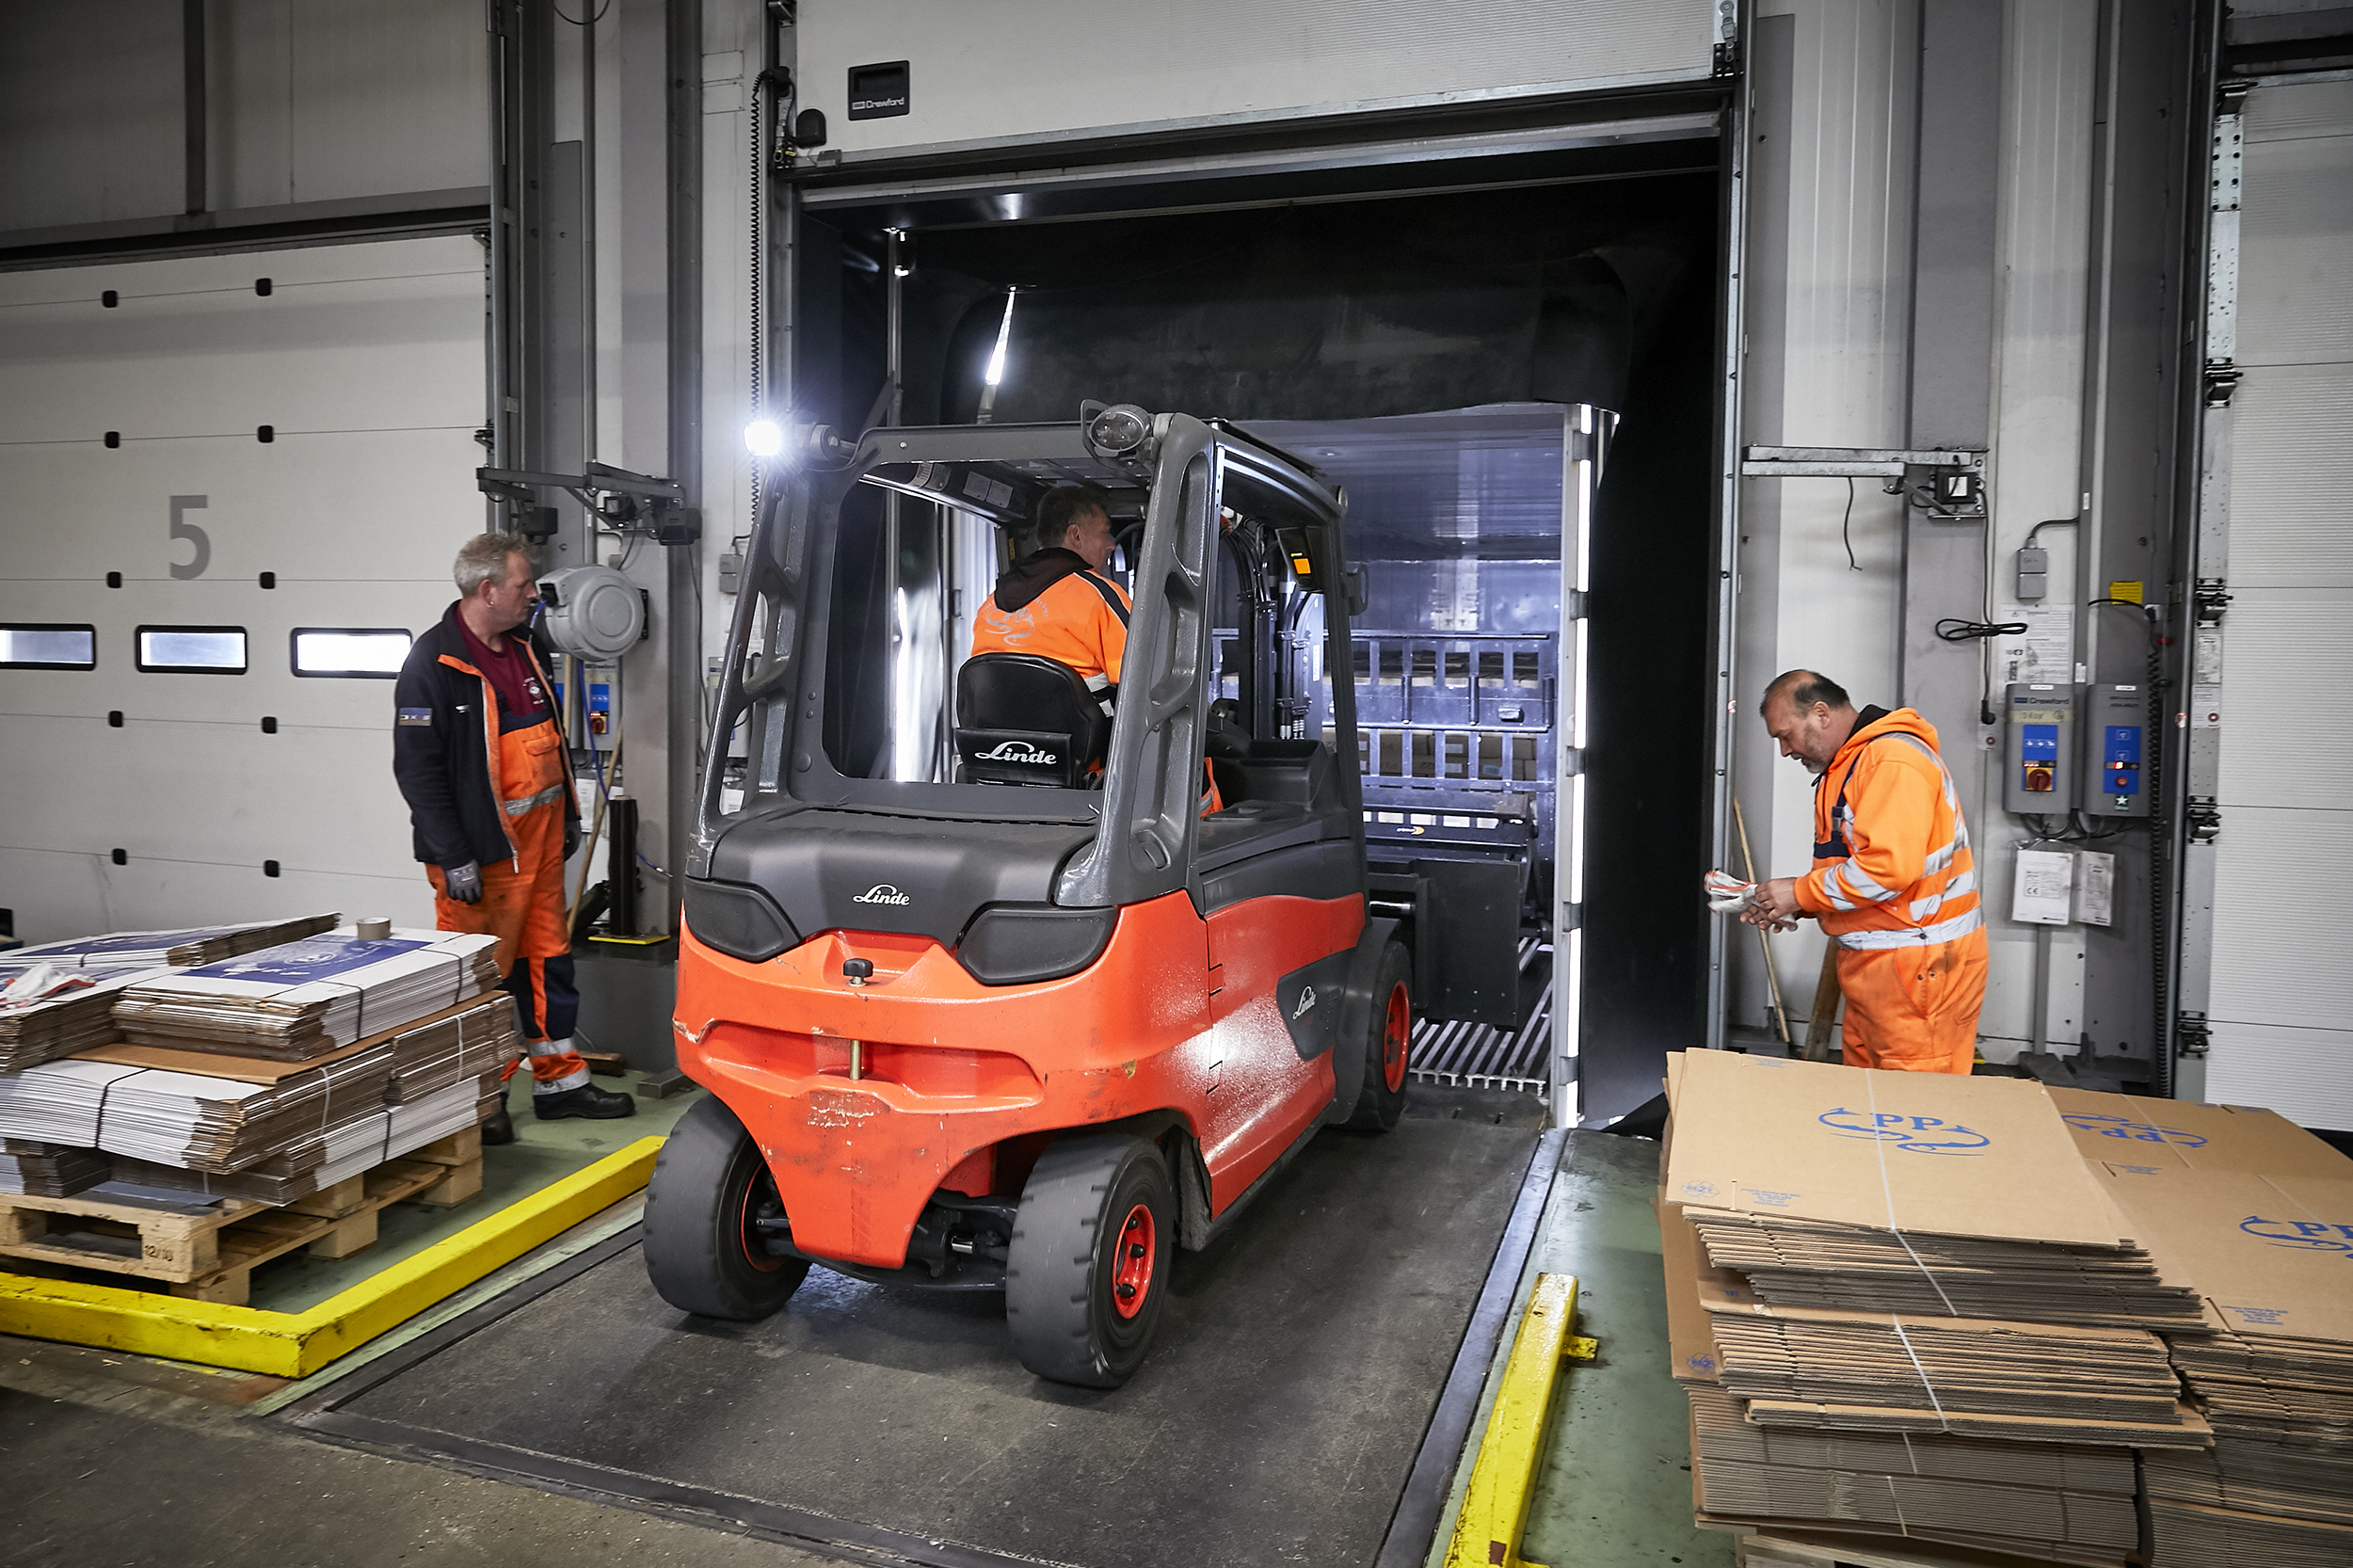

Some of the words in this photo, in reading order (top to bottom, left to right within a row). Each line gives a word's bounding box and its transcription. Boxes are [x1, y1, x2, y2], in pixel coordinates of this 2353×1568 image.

[170, 494, 211, 581] 5
[974, 741, 1057, 765] Linde
[852, 884, 910, 905] Linde
[1292, 985, 1317, 1020] Linde
